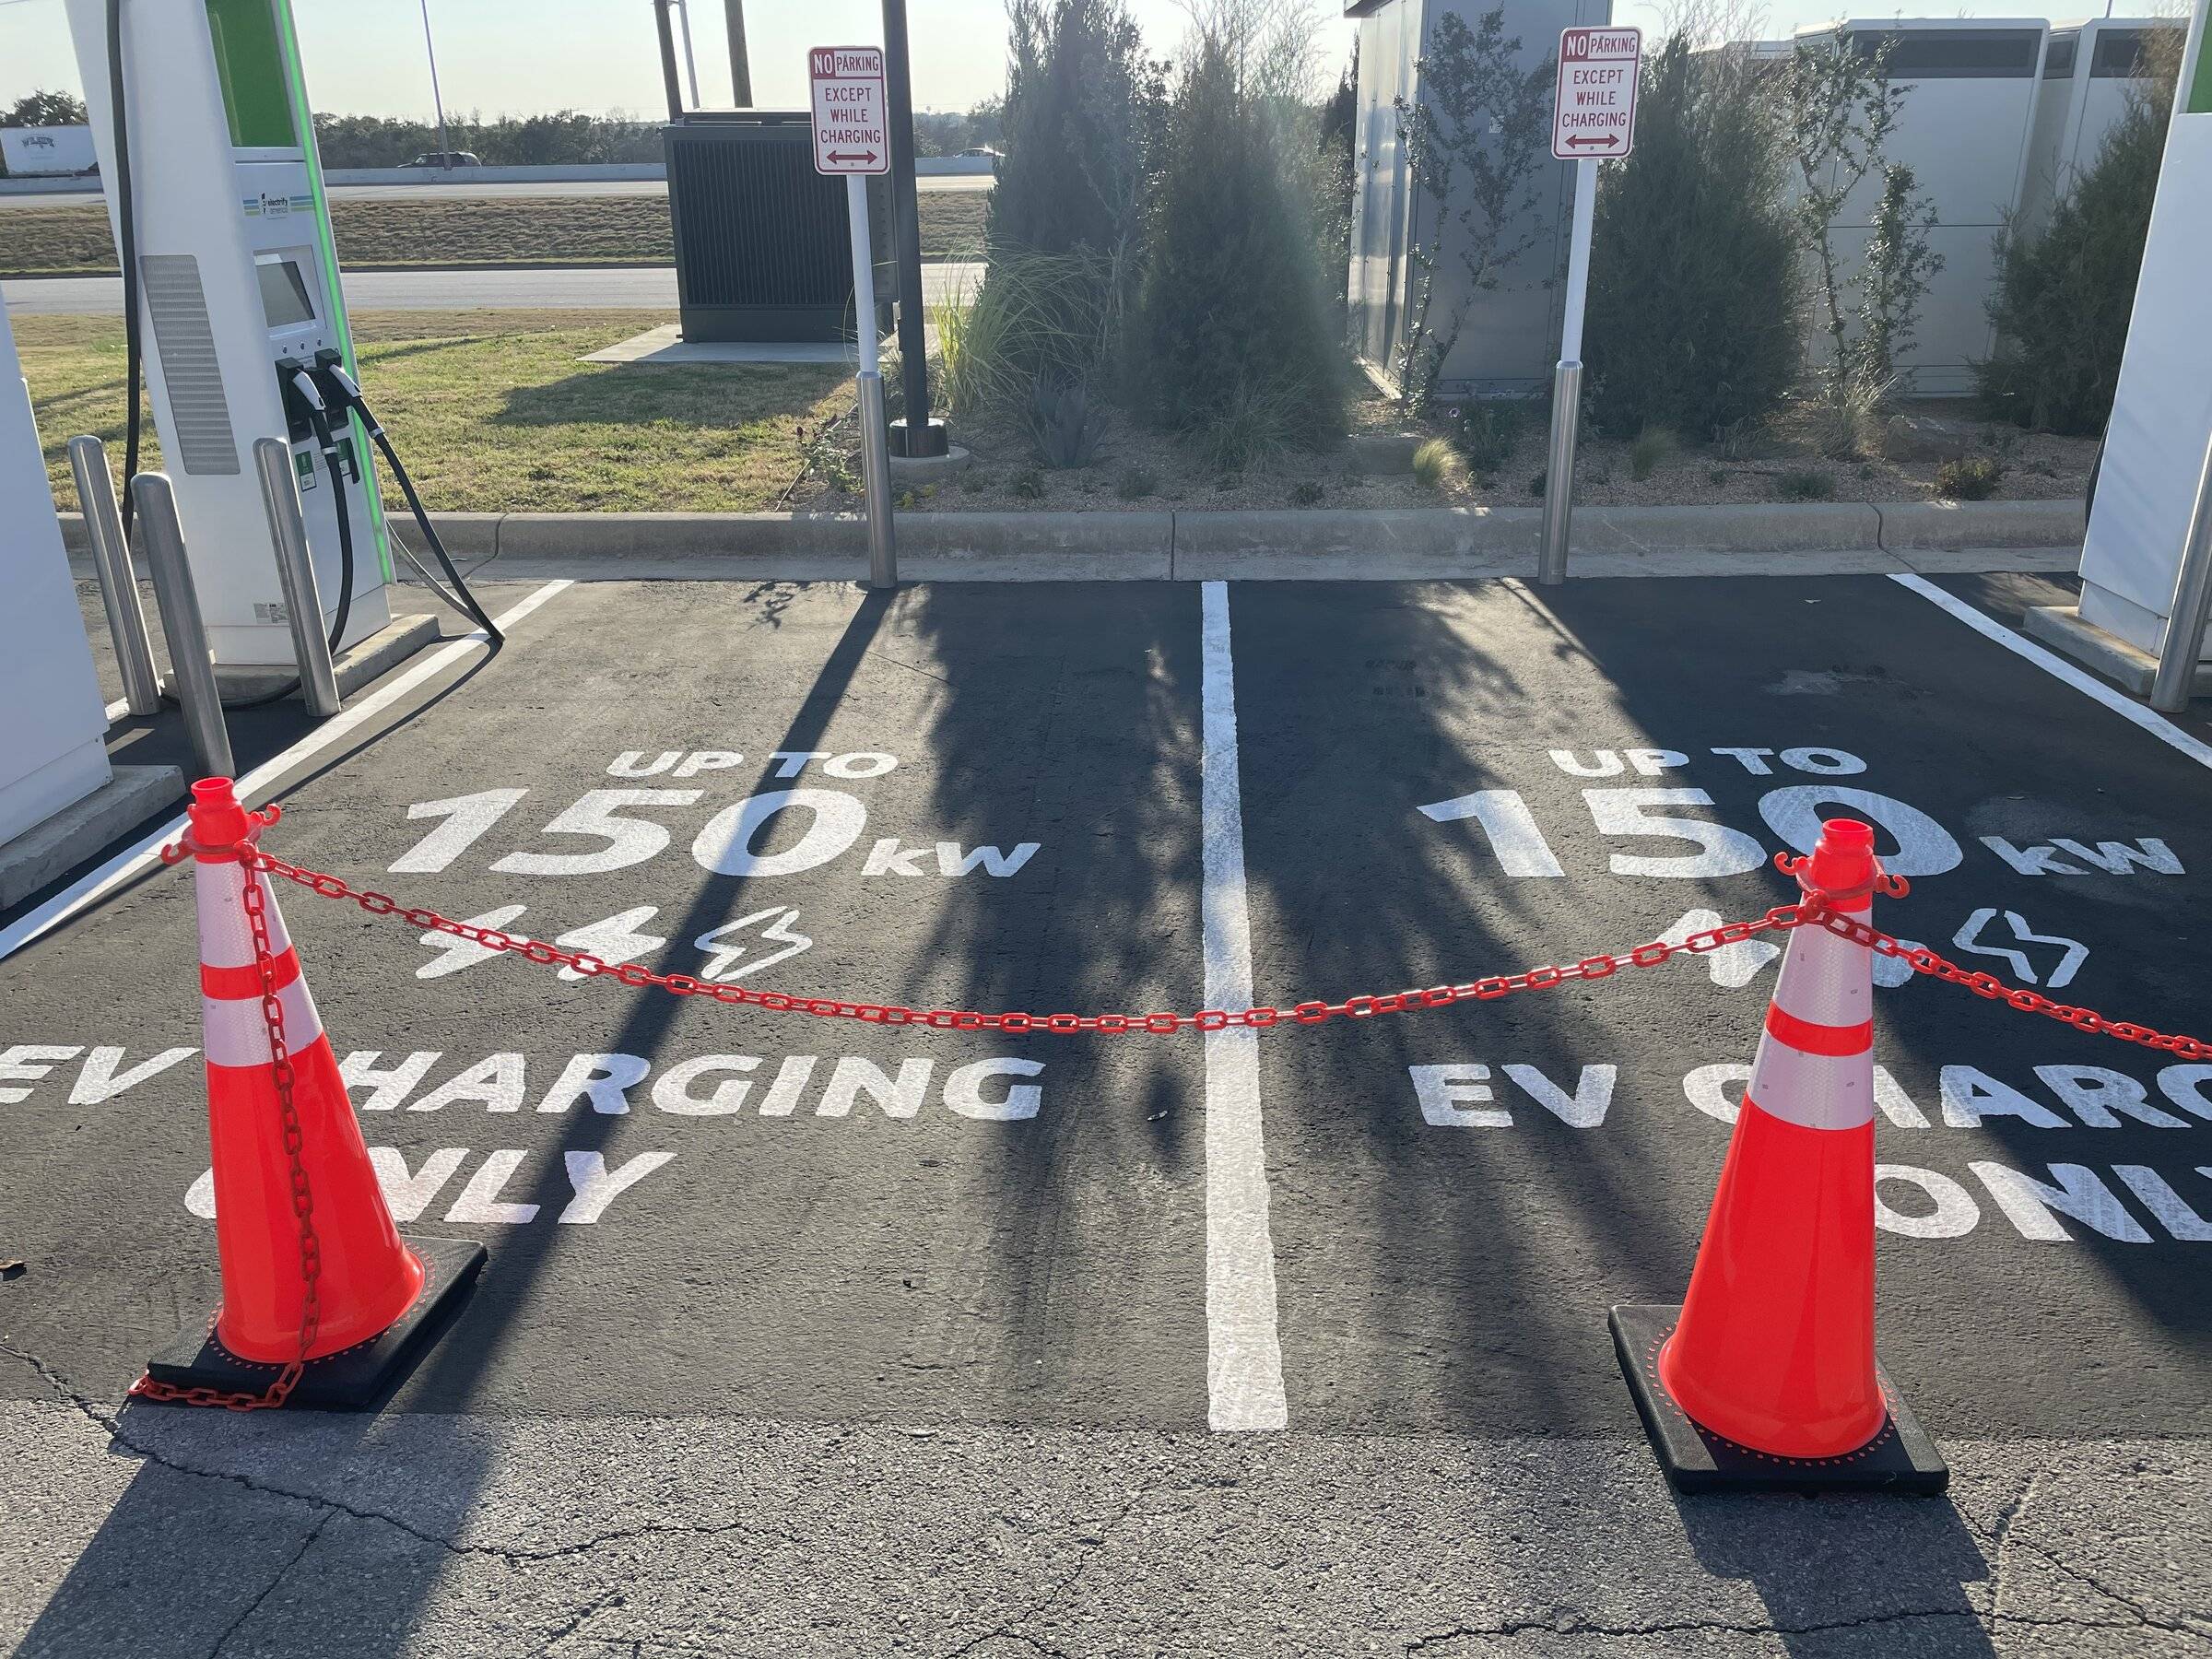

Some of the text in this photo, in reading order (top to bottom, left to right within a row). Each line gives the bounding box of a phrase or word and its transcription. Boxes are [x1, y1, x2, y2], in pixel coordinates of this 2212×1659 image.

[1566, 35, 1636, 56] NO PARKING
[814, 53, 879, 75] NO PARKING
[1573, 69, 1624, 85] EXCEPT
[825, 88, 872, 102] EXCEPT
[1576, 90, 1617, 106] WHILE
[830, 109, 869, 123] WHILE
[1562, 112, 1627, 128] CHARGING
[820, 129, 881, 144] CHARGING
[606, 750, 899, 779] UP TO
[1548, 747, 1867, 778] UP TO
[387, 787, 868, 877] 150
[1417, 784, 1963, 878] 150
[0, 1045, 1046, 1121] EV HARGING
[1409, 1063, 1617, 1128] EV
